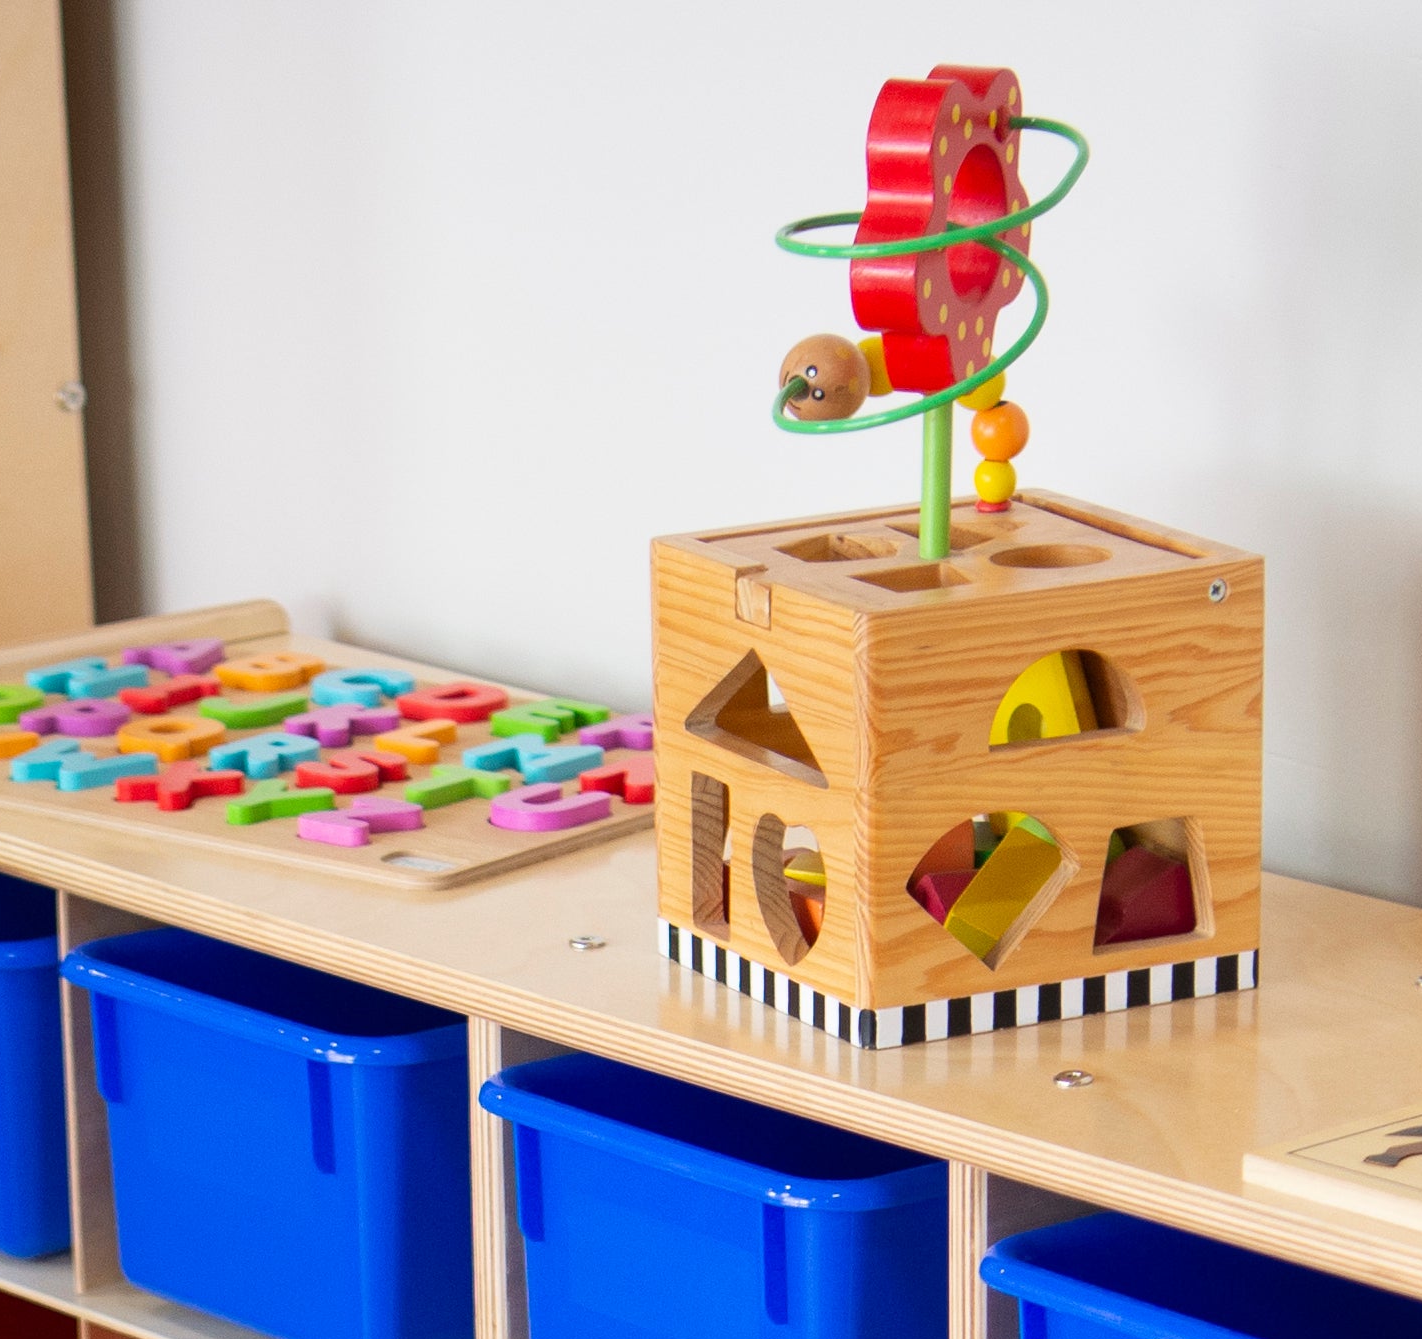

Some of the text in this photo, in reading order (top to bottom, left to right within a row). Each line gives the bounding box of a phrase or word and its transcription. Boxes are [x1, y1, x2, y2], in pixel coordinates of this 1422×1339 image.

[122, 638, 225, 675] A
[213, 652, 327, 692] B
[311, 668, 415, 707] C
[396, 681, 508, 723] D
[490, 699, 610, 743] E
[200, 693, 308, 729] J
[283, 703, 400, 748] K
[373, 718, 458, 764] L
[462, 733, 605, 785] M
[11, 739, 158, 791] W
[116, 761, 245, 811] X
[226, 779, 335, 826] Y
[298, 796, 423, 848] Z
[19, 698, 131, 737] P
[118, 716, 226, 762] Q
[208, 732, 320, 780] R
[295, 751, 408, 794] S
[405, 764, 511, 809] T
[490, 782, 611, 832] U
